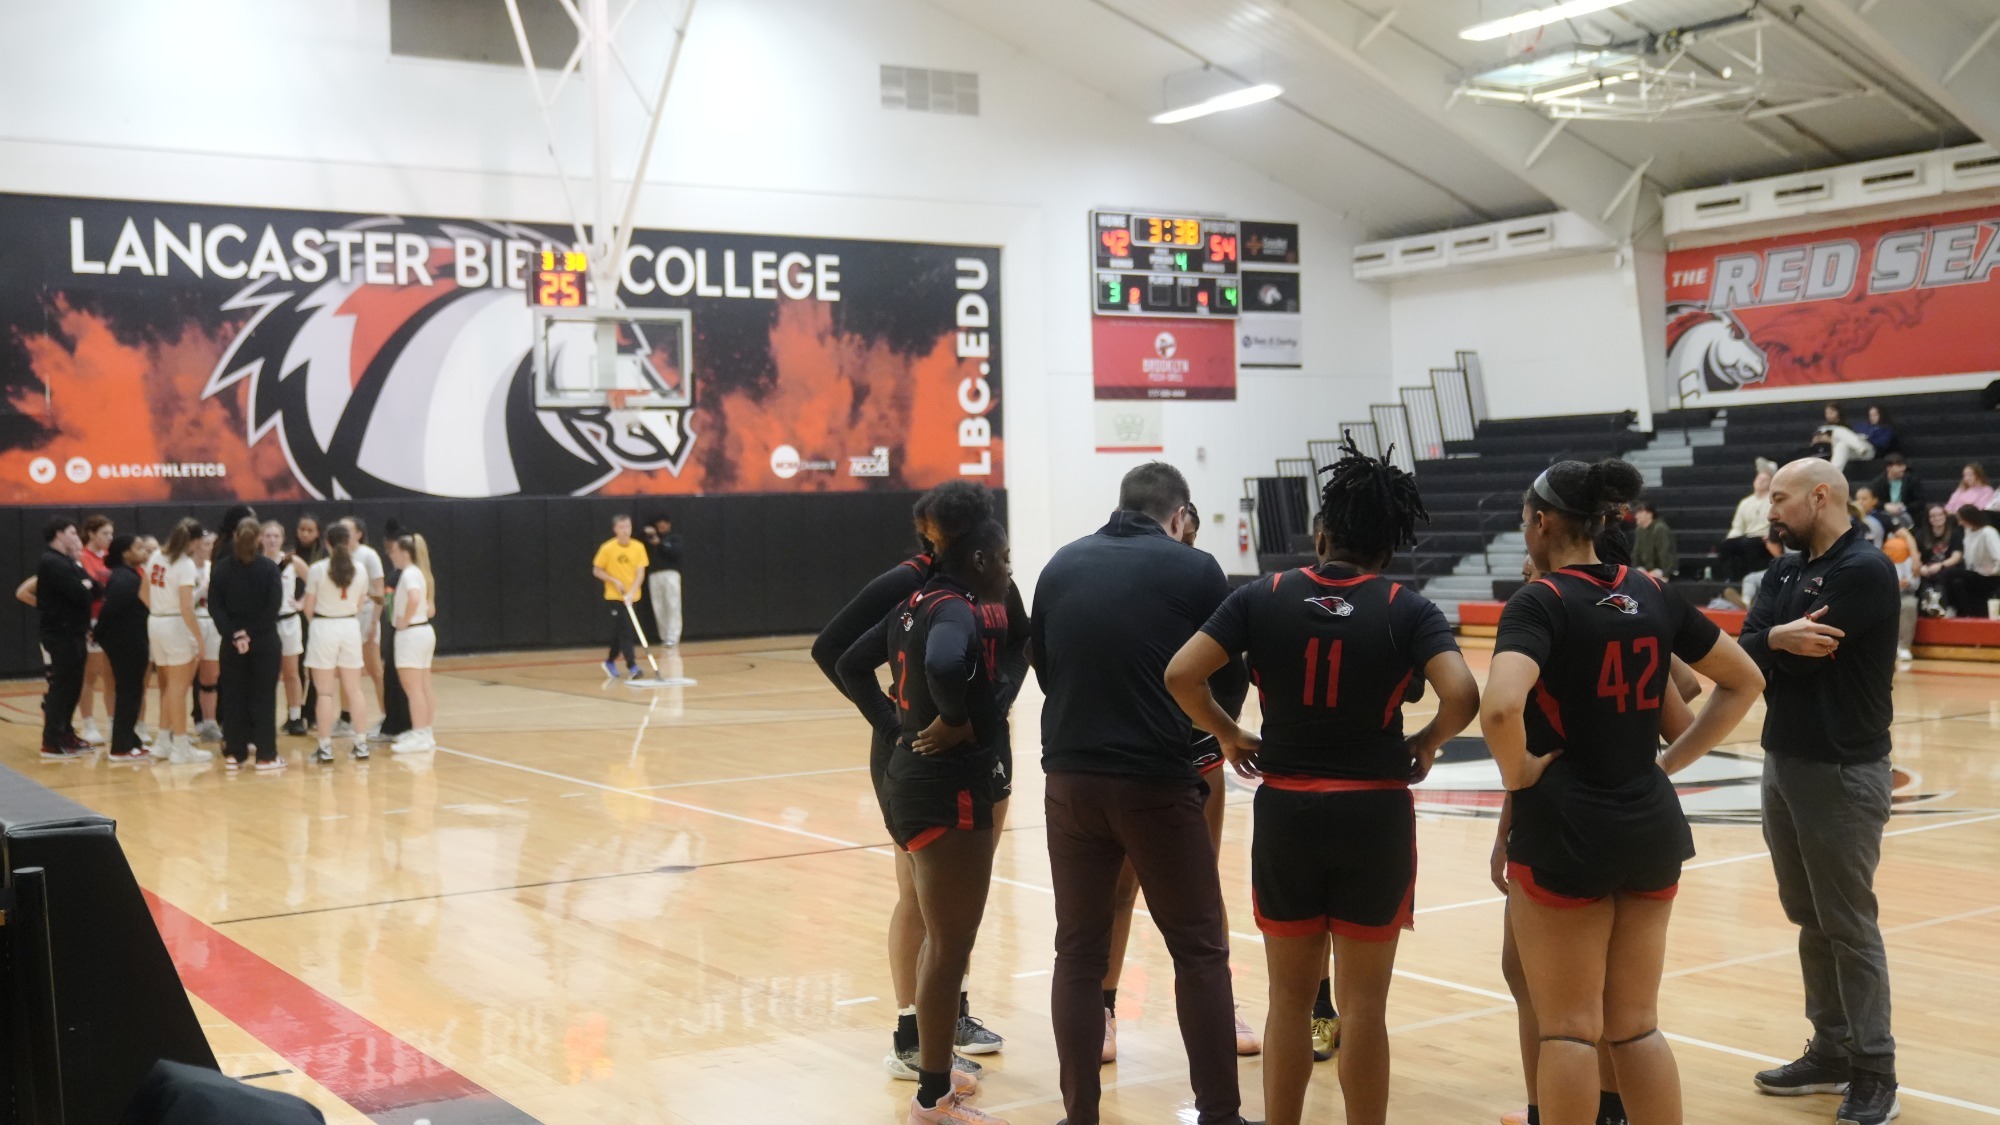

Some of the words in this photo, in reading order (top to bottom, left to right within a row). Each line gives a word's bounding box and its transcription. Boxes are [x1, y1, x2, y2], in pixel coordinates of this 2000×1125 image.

[1148, 217, 1199, 246] 3:38
[1210, 234, 1237, 262] 54
[70, 216, 433, 286] LANCASTER
[621, 244, 840, 301] COLLEGE
[1175, 252, 1188, 272] 4
[1671, 267, 1708, 287] THE
[1708, 238, 1860, 313] RED
[539, 272, 580, 307] 25
[1108, 281, 1121, 303] 3
[1224, 287, 1237, 307] 4
[955, 257, 992, 476] LBC.EDU
[97, 462, 227, 479] @LBCATHLETICS
[897, 651, 910, 711] 2
[1303, 637, 1343, 708] 11
[1596, 636, 1660, 713] 42
